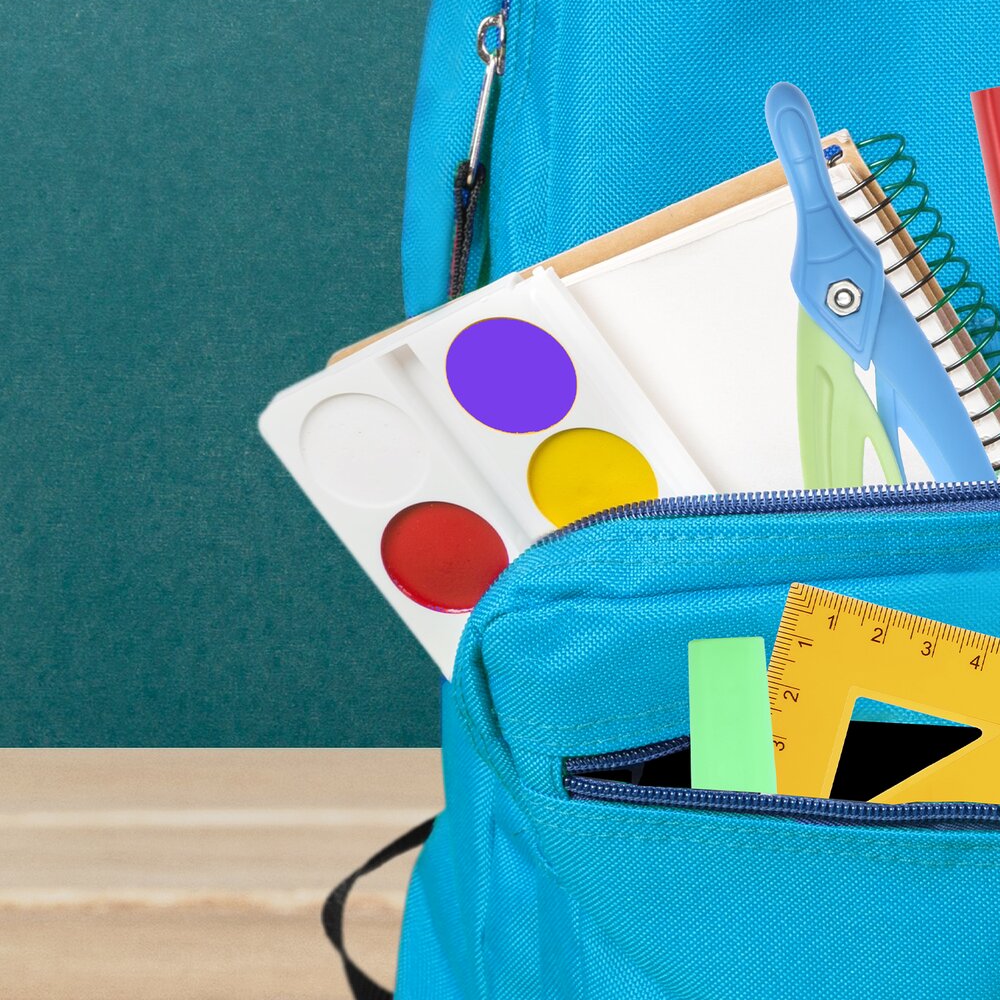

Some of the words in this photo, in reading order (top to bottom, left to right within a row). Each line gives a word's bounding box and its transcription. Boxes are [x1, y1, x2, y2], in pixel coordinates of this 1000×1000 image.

[797, 640, 813, 648] 1
[827, 615, 835, 630] 1
[870, 627, 884, 644] 2
[920, 641, 932, 656] 3
[969, 655, 981, 670] 4
[783, 690, 799, 702] 2
[772, 739, 785, 751] 3
